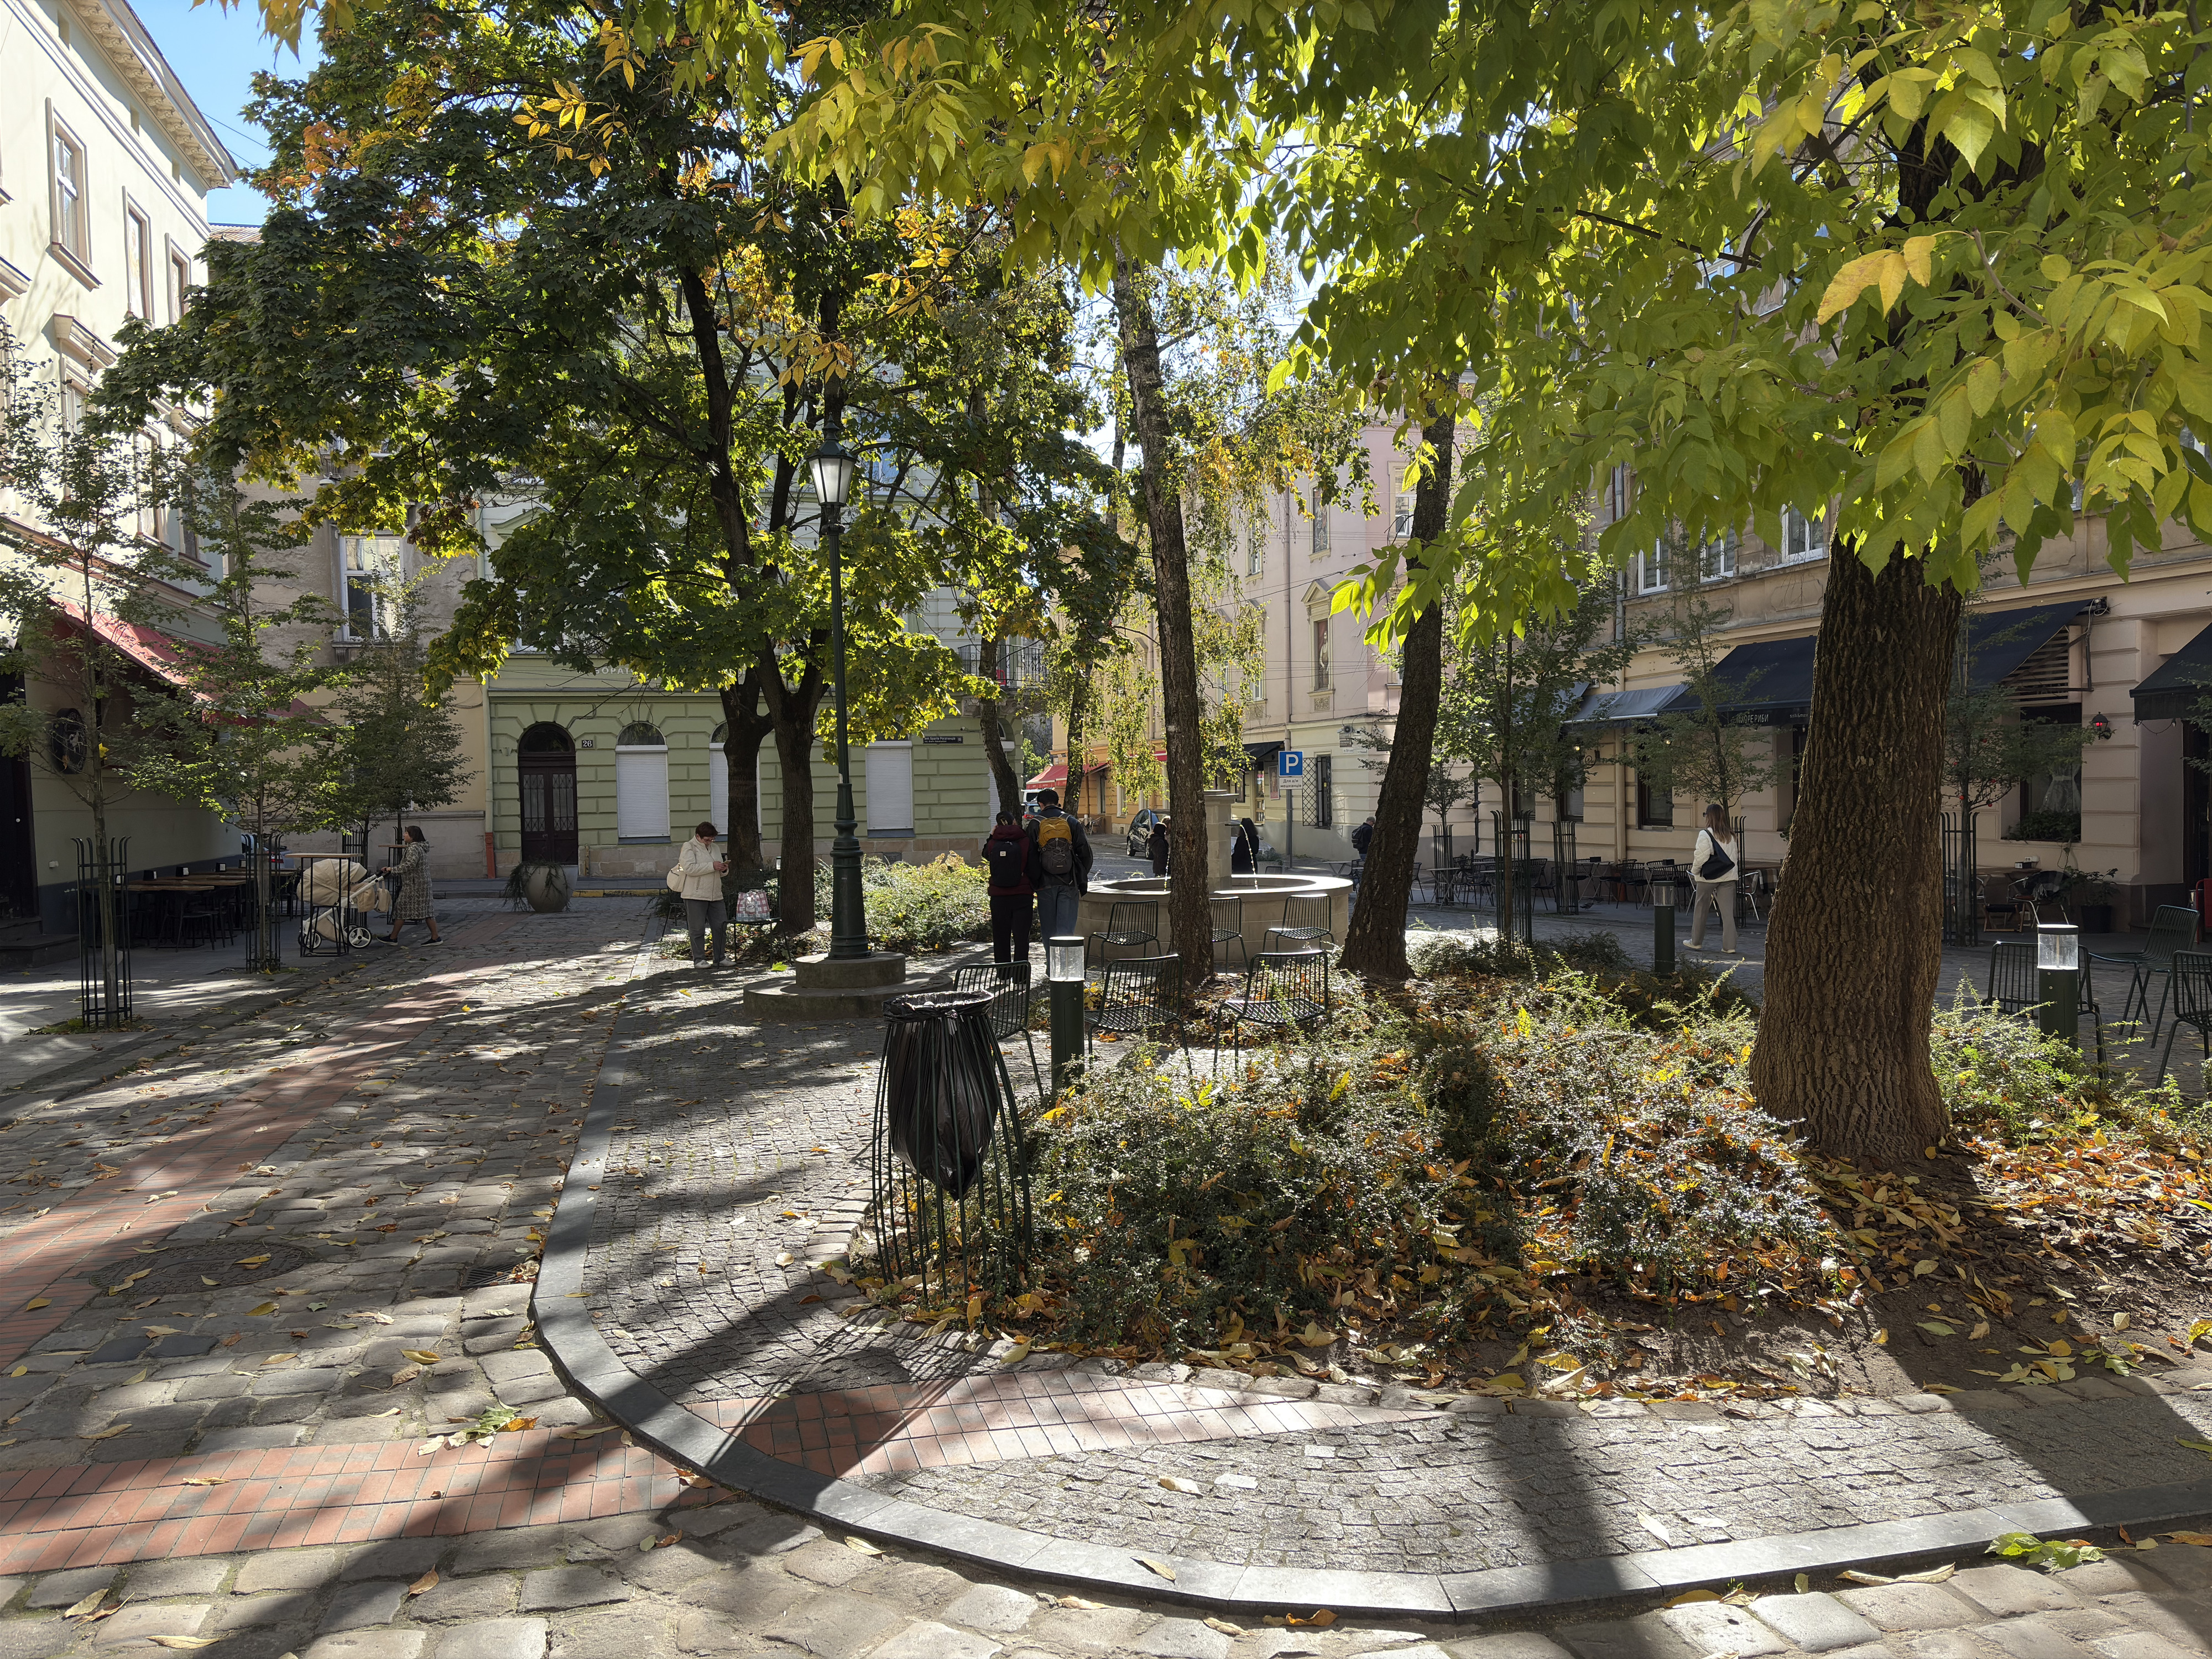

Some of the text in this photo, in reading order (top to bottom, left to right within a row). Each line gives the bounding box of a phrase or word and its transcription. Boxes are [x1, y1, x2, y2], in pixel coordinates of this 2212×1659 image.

[1739, 714, 1769, 723] МОРЕ РИБИ
[1286, 754, 1299, 773] P
